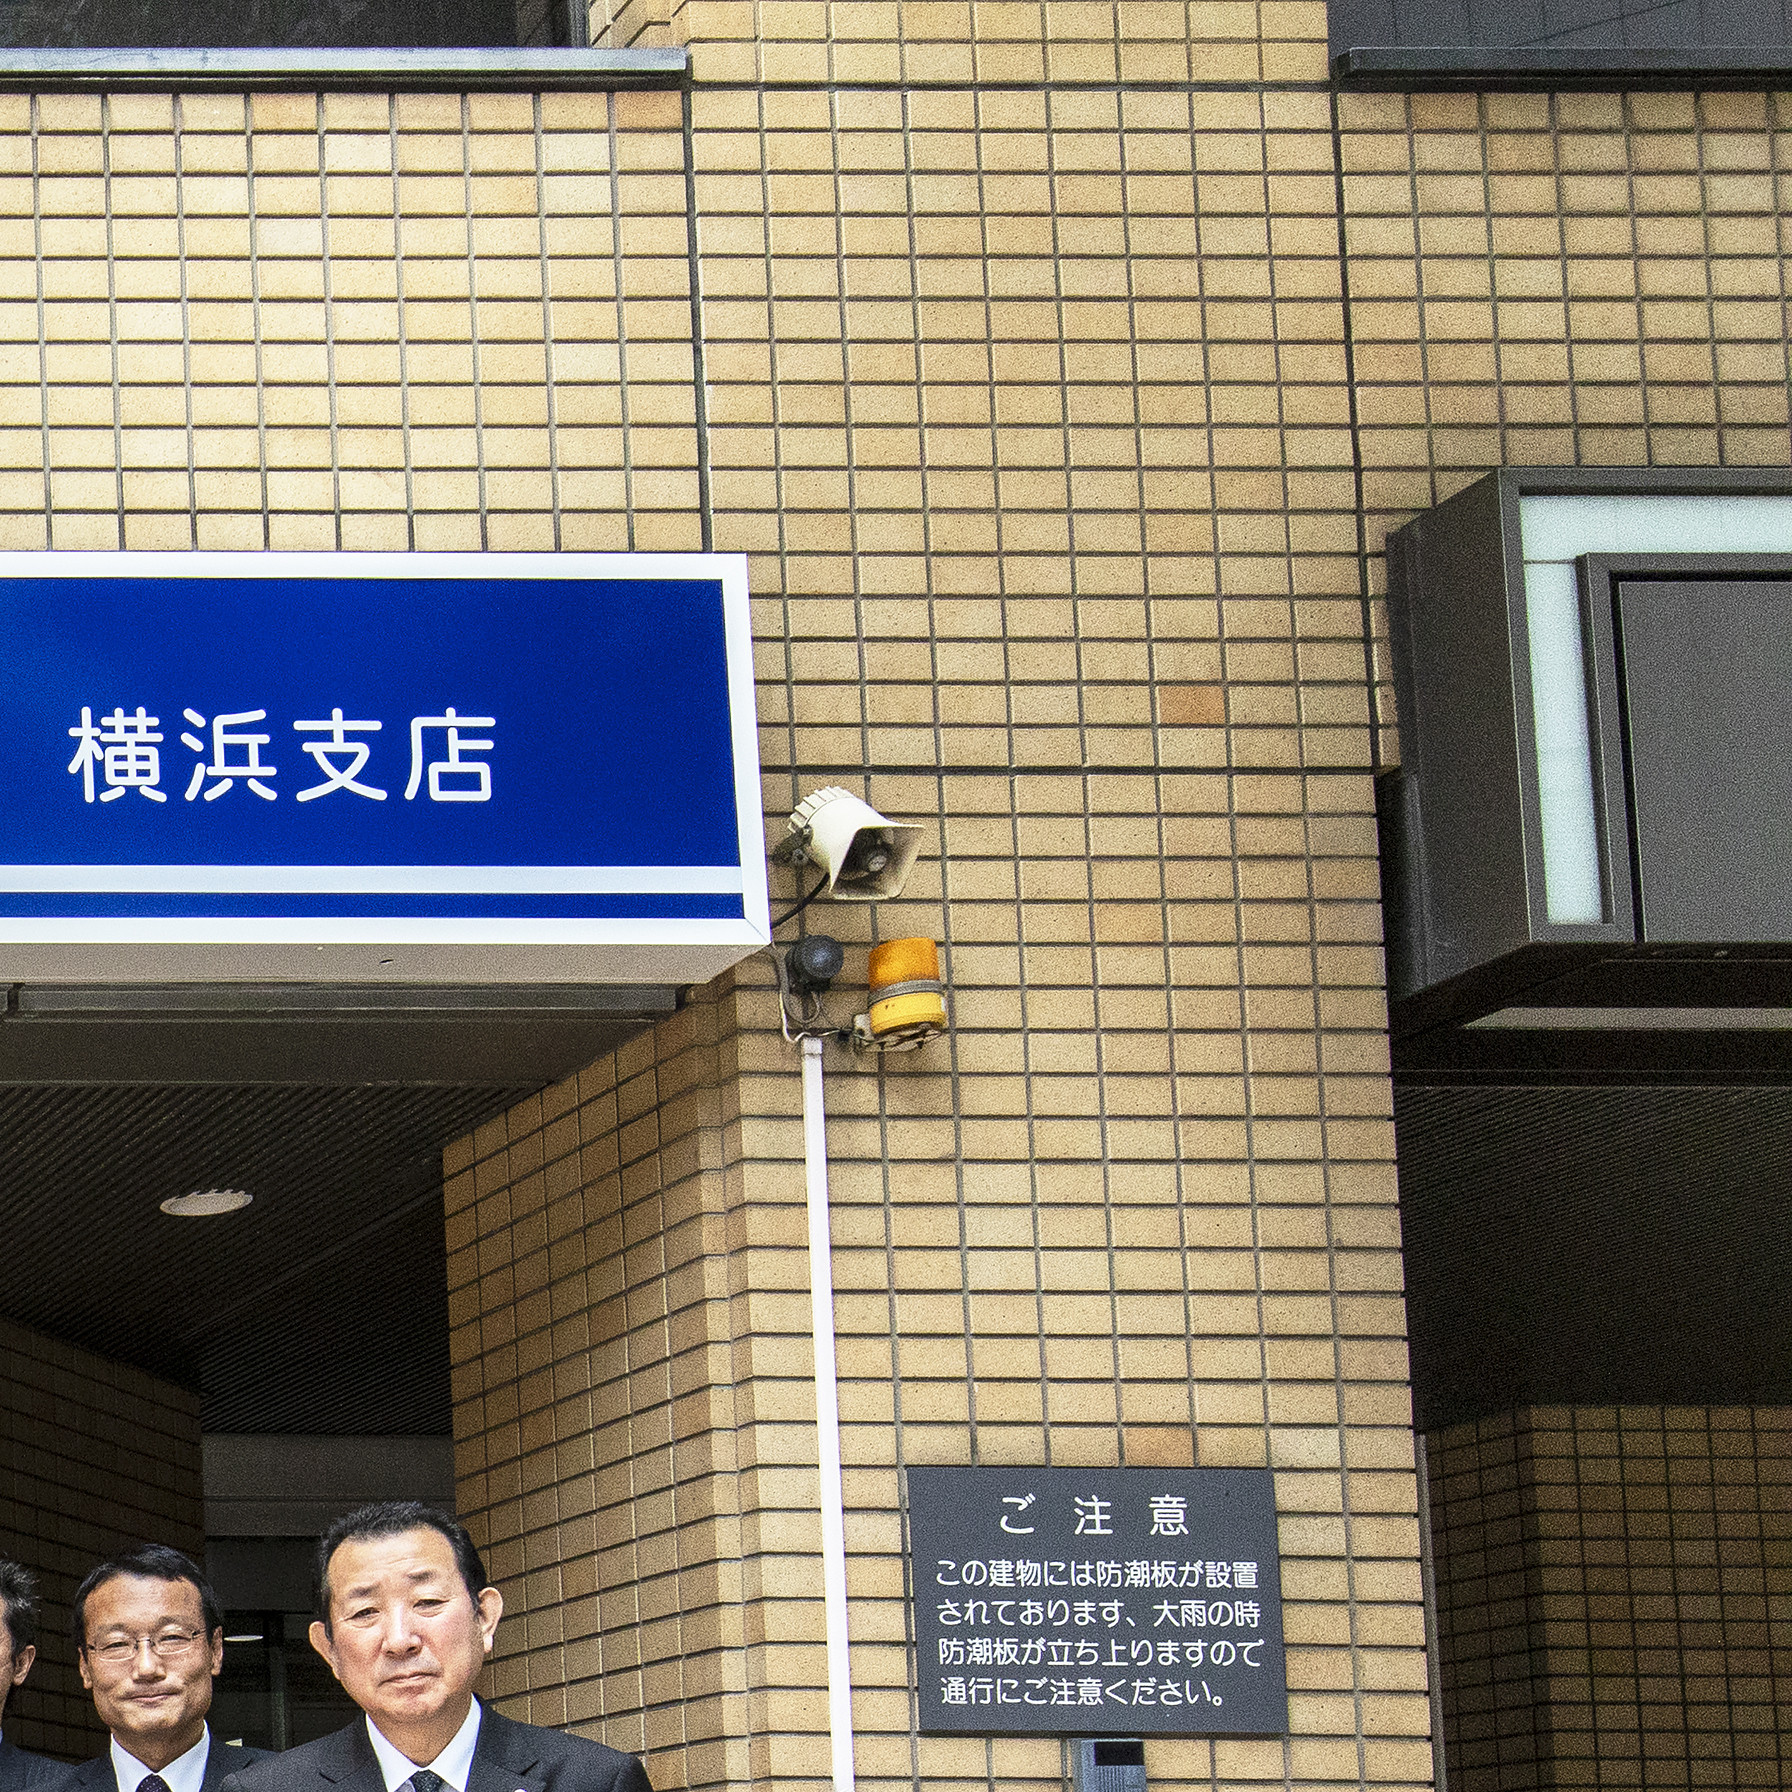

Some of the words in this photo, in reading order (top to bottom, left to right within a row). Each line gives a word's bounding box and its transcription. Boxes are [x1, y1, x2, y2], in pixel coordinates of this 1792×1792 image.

[68, 707, 495, 803] 横浜支店
[1000, 1493, 1188, 1535] ご注意
[937, 1560, 1258, 1589] この建物には防潮板が設置
[937, 1599, 1260, 1628] されております、大雨の時
[939, 1638, 1264, 1667] 防潮板が立ち上りますので
[941, 1677, 1224, 1706] 通行にご注意ください。
